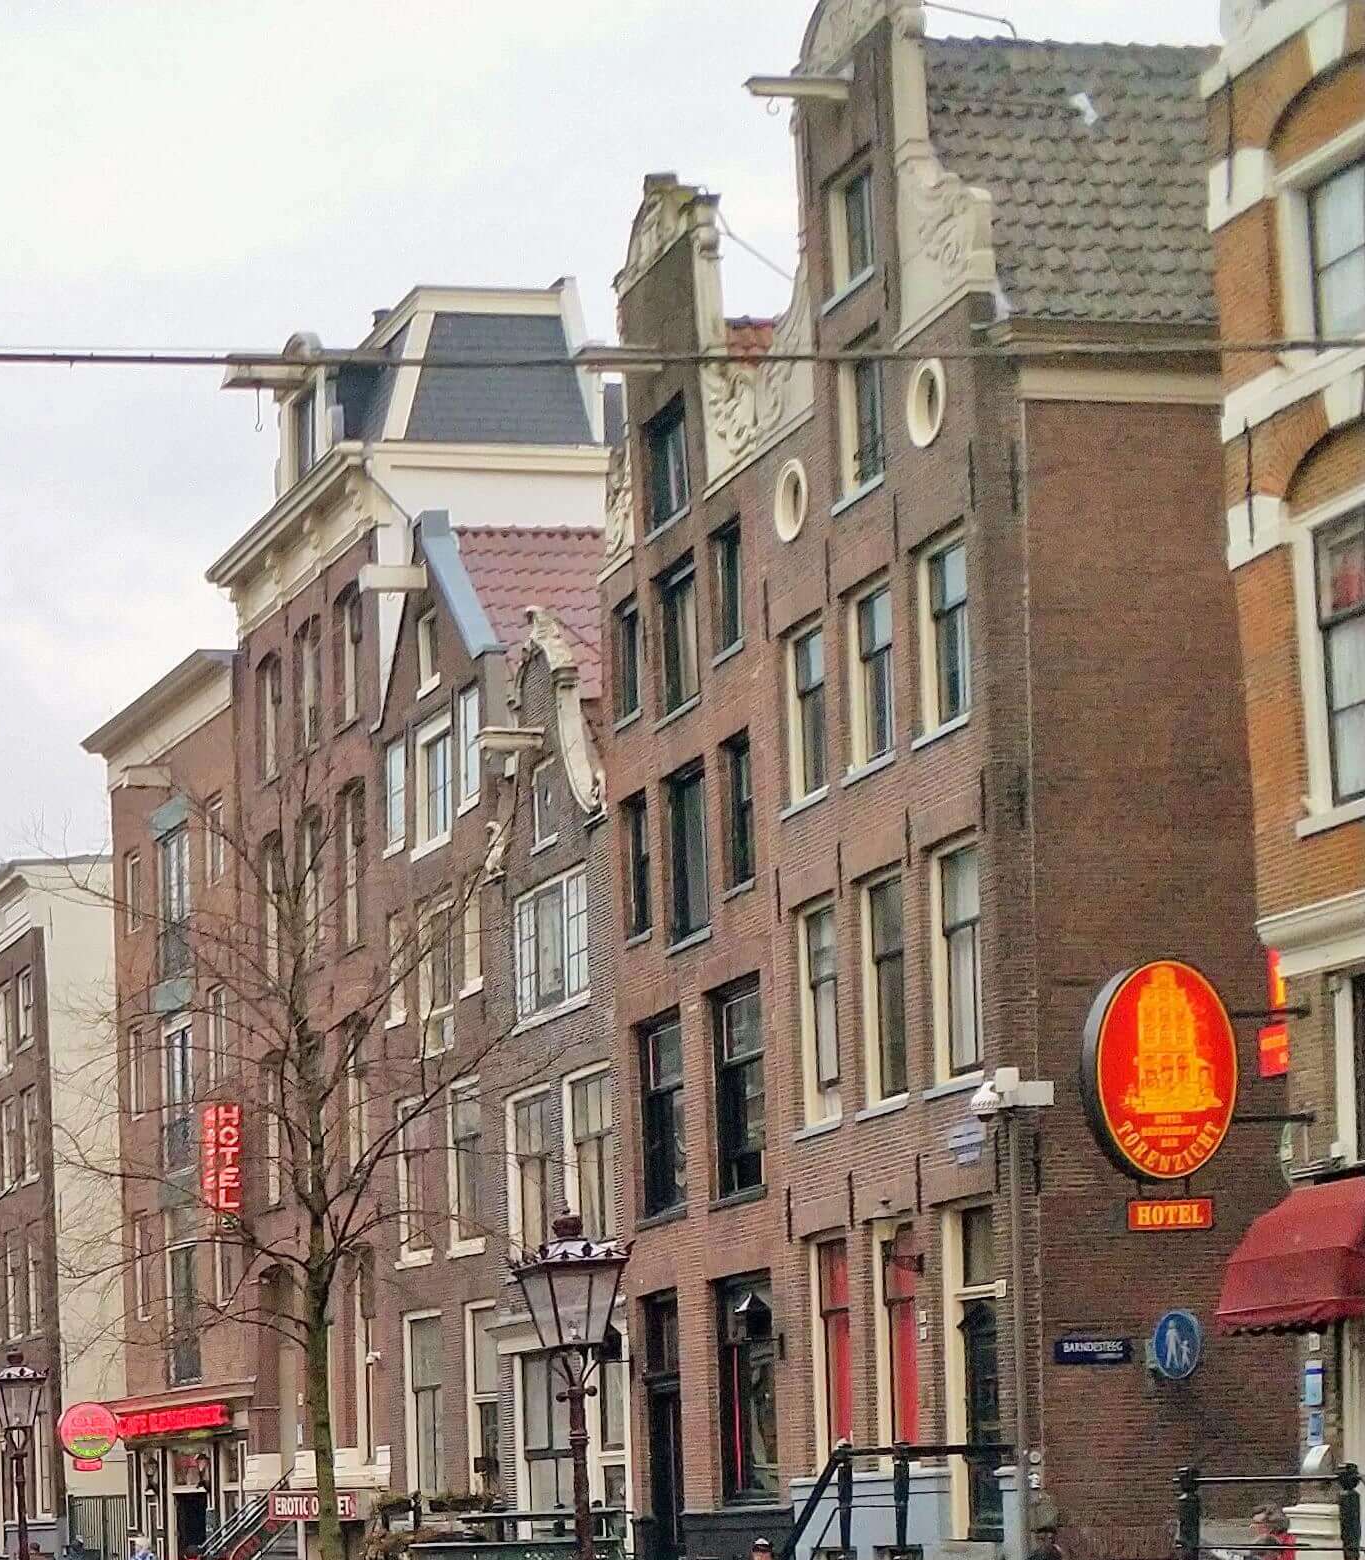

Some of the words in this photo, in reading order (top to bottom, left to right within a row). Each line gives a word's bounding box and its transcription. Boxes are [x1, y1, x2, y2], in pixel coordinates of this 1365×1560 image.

[218, 1105, 240, 1208] HOTEL
[1117, 1120, 1221, 1172] TORENZICHT
[1136, 1204, 1205, 1226] HOTEL
[275, 1496, 309, 1516] EROTIC
